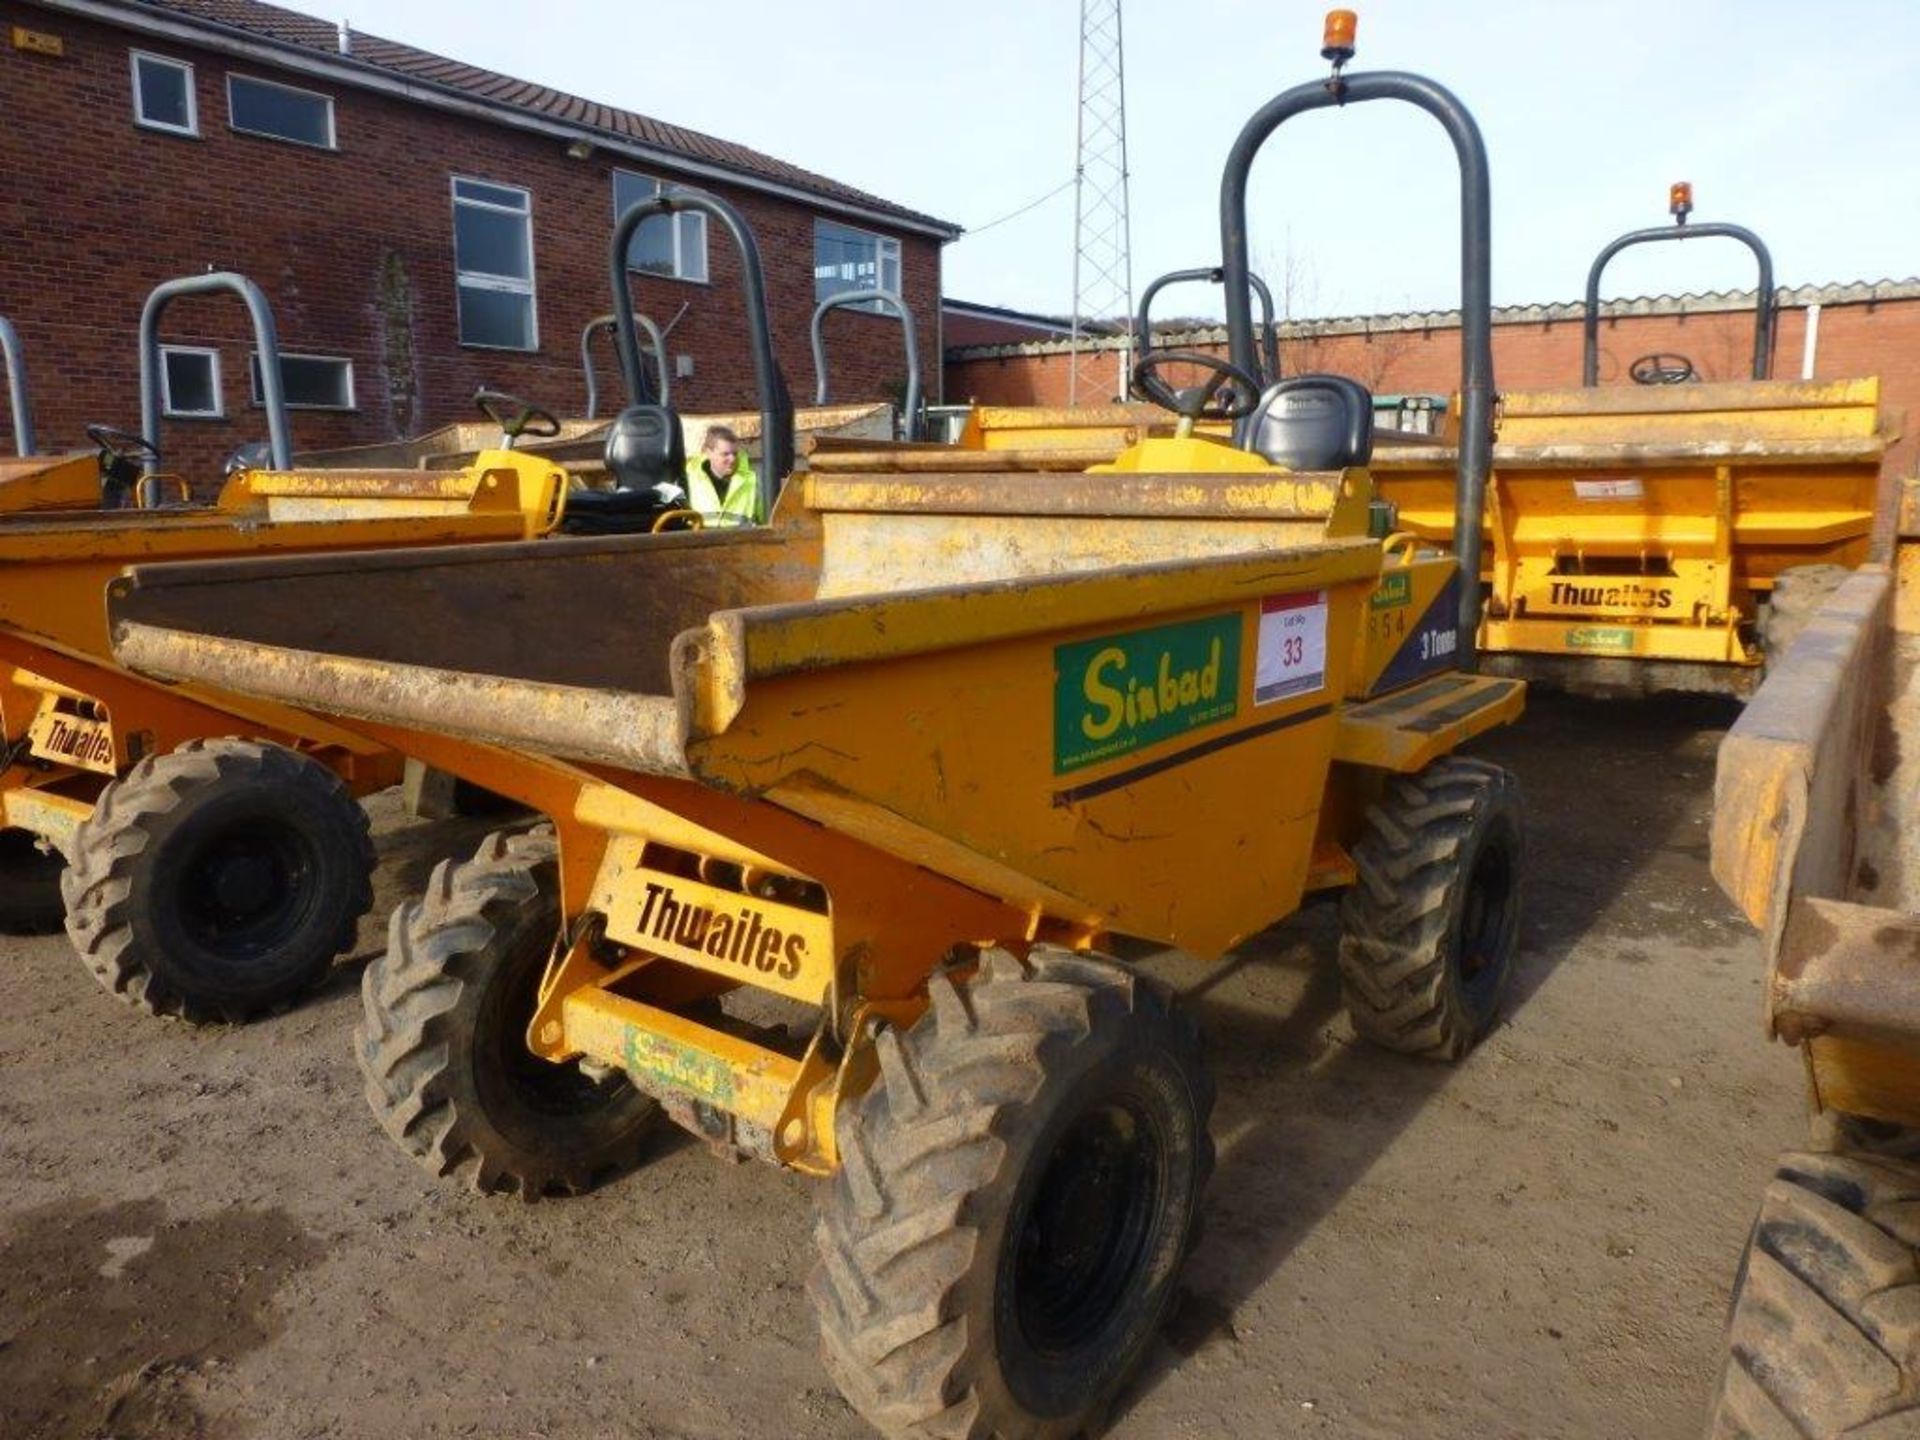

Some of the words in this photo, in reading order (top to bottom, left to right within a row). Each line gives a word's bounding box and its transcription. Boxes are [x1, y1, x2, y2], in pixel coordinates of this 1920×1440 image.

[1550, 582, 1672, 608] Thwaites
[1283, 636, 1303, 667] 33
[1420, 631, 1430, 660] 3
[1082, 636, 1220, 740] Sinbad
[46, 719, 113, 764] Thwaites
[637, 882, 806, 980] Thwaites
